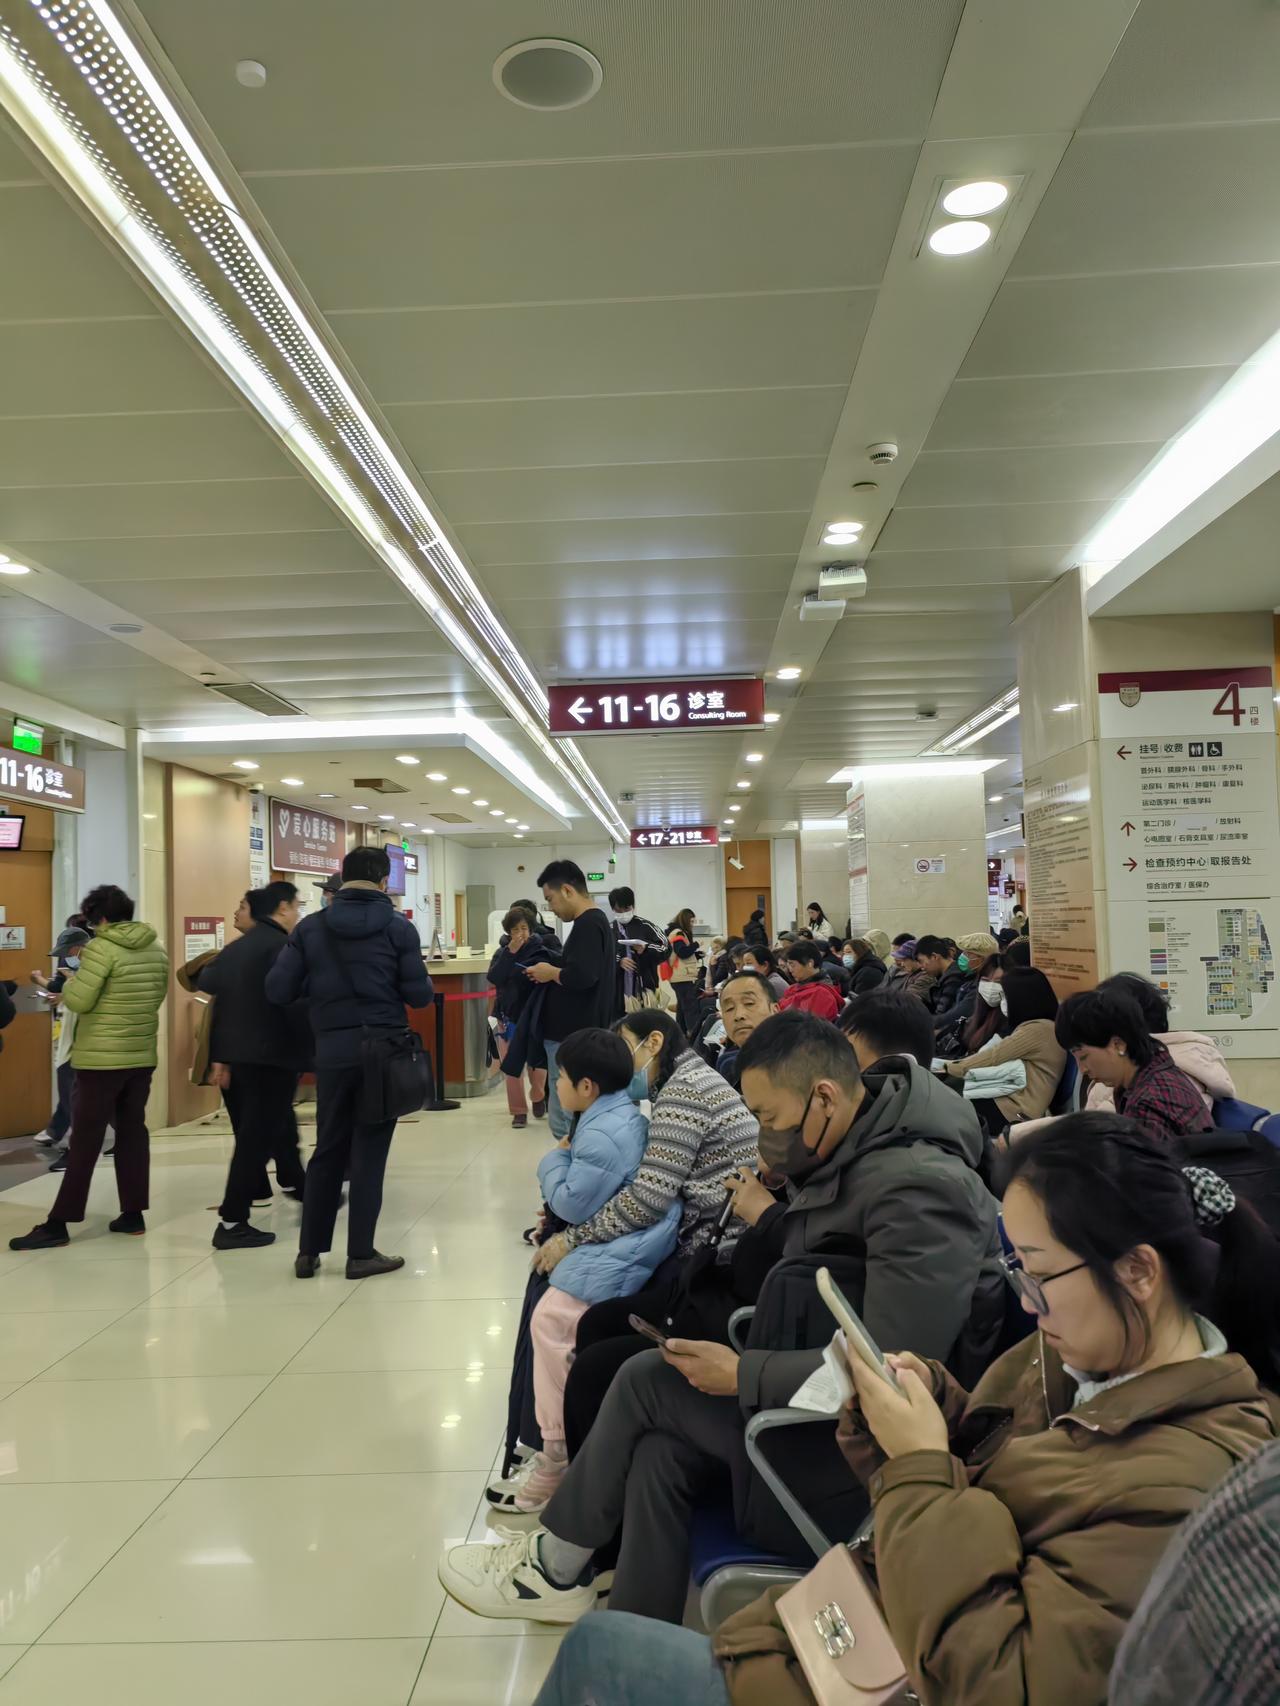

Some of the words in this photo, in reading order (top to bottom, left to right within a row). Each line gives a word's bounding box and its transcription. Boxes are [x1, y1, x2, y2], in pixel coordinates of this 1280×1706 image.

[598, 694, 680, 722] 11-16
[687, 691, 725, 709] 诊室
[1213, 682, 1246, 726] 4
[688, 711, 724, 720] Consulting
[726, 710, 746, 718] Room
[1250, 706, 1260, 726] 四楼
[1139, 743, 1159, 754] 挂号
[1164, 743, 1183, 753] 收费
[0, 757, 44, 793] 11-16
[649, 832, 685, 845] 17-21
[1145, 857, 1206, 868] 检查预约中心
[1210, 855, 1251, 866] 取报告处
